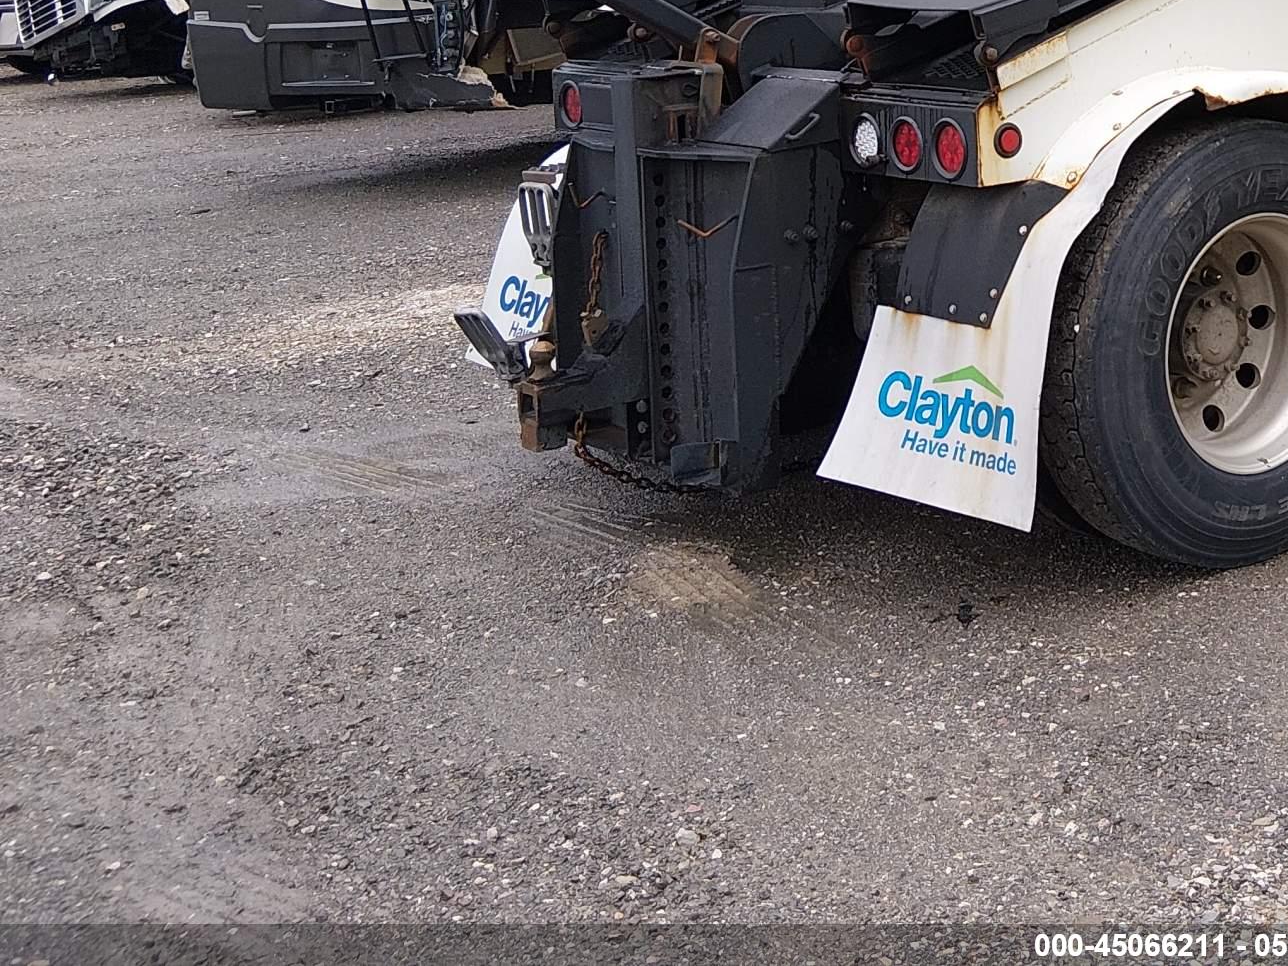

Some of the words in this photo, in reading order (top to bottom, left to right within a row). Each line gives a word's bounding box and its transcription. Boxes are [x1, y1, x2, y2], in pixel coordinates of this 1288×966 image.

[499, 275, 550, 328] Clay
[877, 370, 1015, 445] Clayton
[900, 429, 949, 459] Have
[952, 440, 967, 463] it
[969, 449, 1017, 476] made
